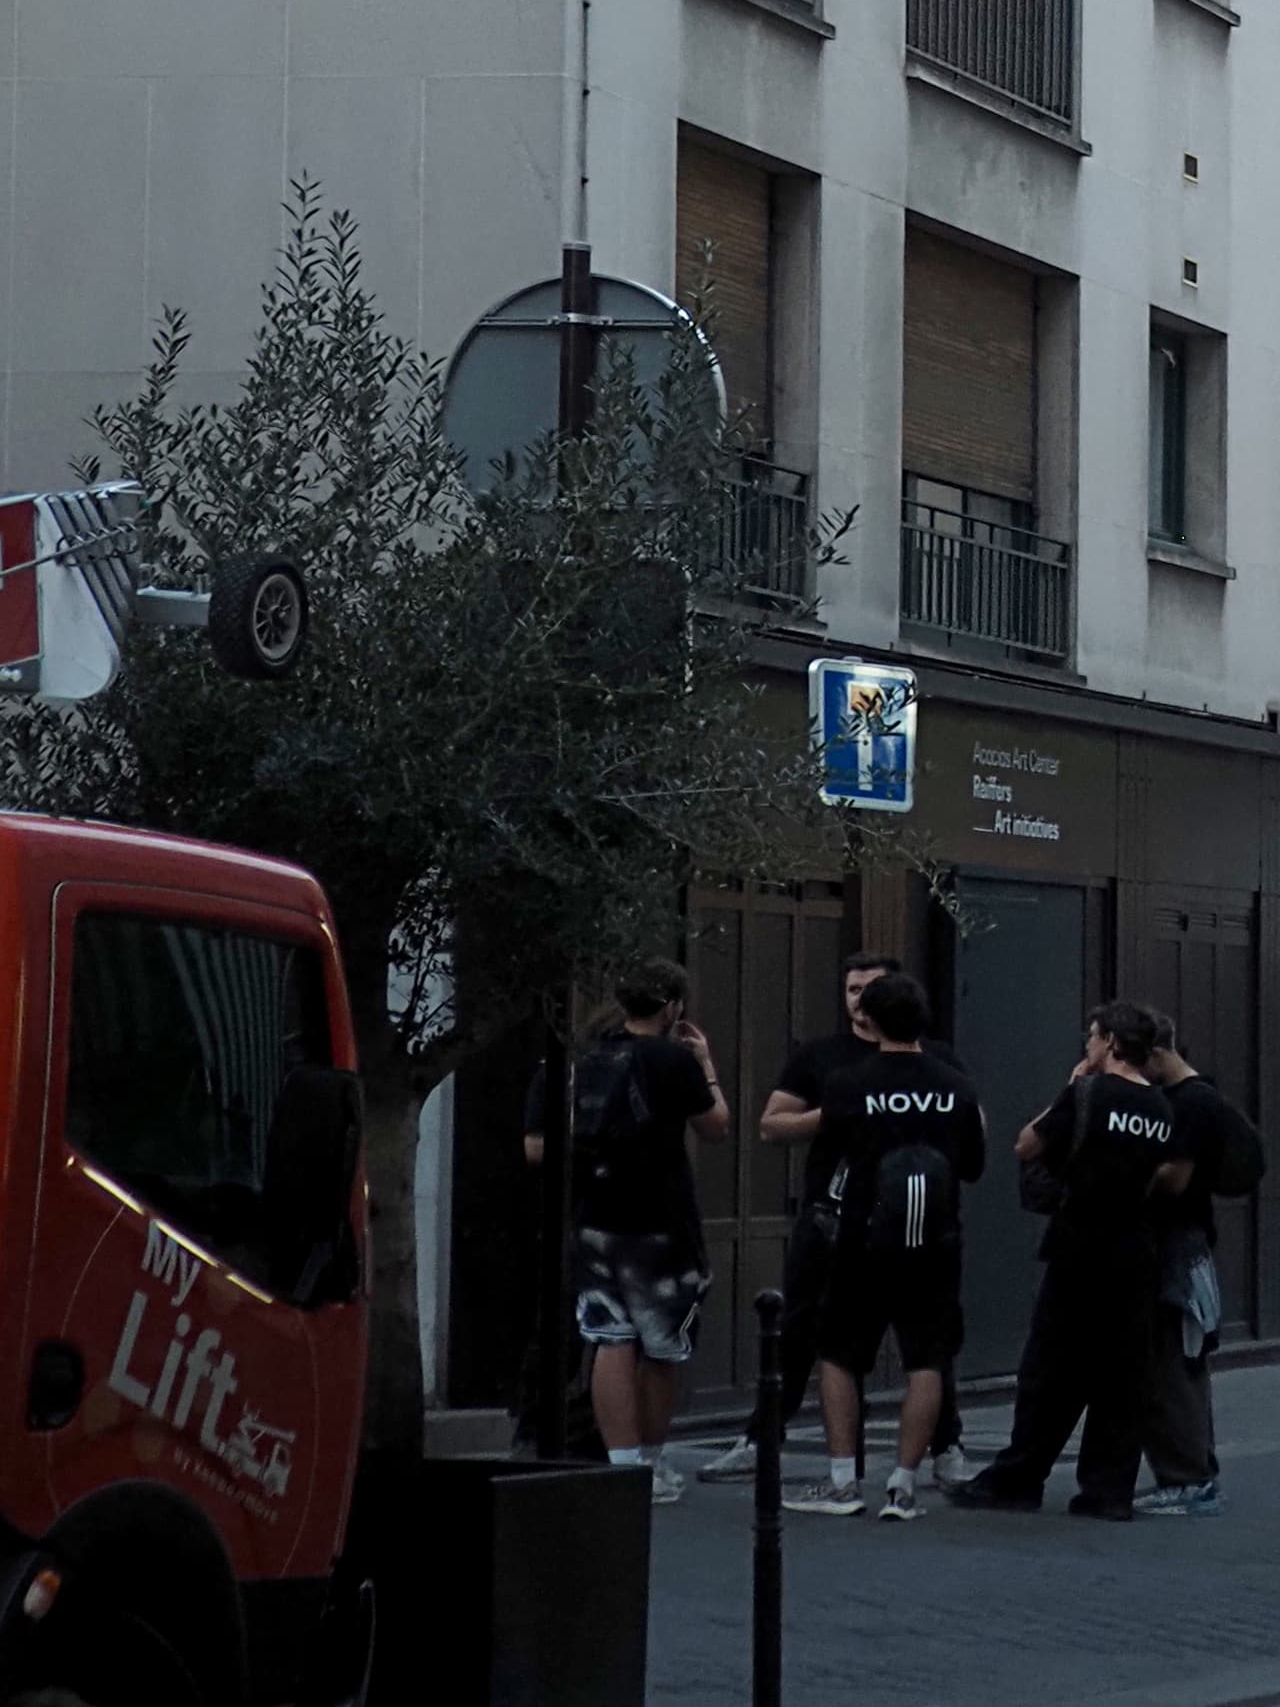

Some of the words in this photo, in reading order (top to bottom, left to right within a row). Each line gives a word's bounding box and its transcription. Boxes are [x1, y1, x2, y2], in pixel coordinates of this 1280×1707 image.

[1012, 747, 1029, 771] Art
[1029, 749, 1060, 777] Center
[865, 1091, 957, 1116] NOVU
[1107, 1110, 1172, 1144] NOVU
[141, 1218, 202, 1308] My
